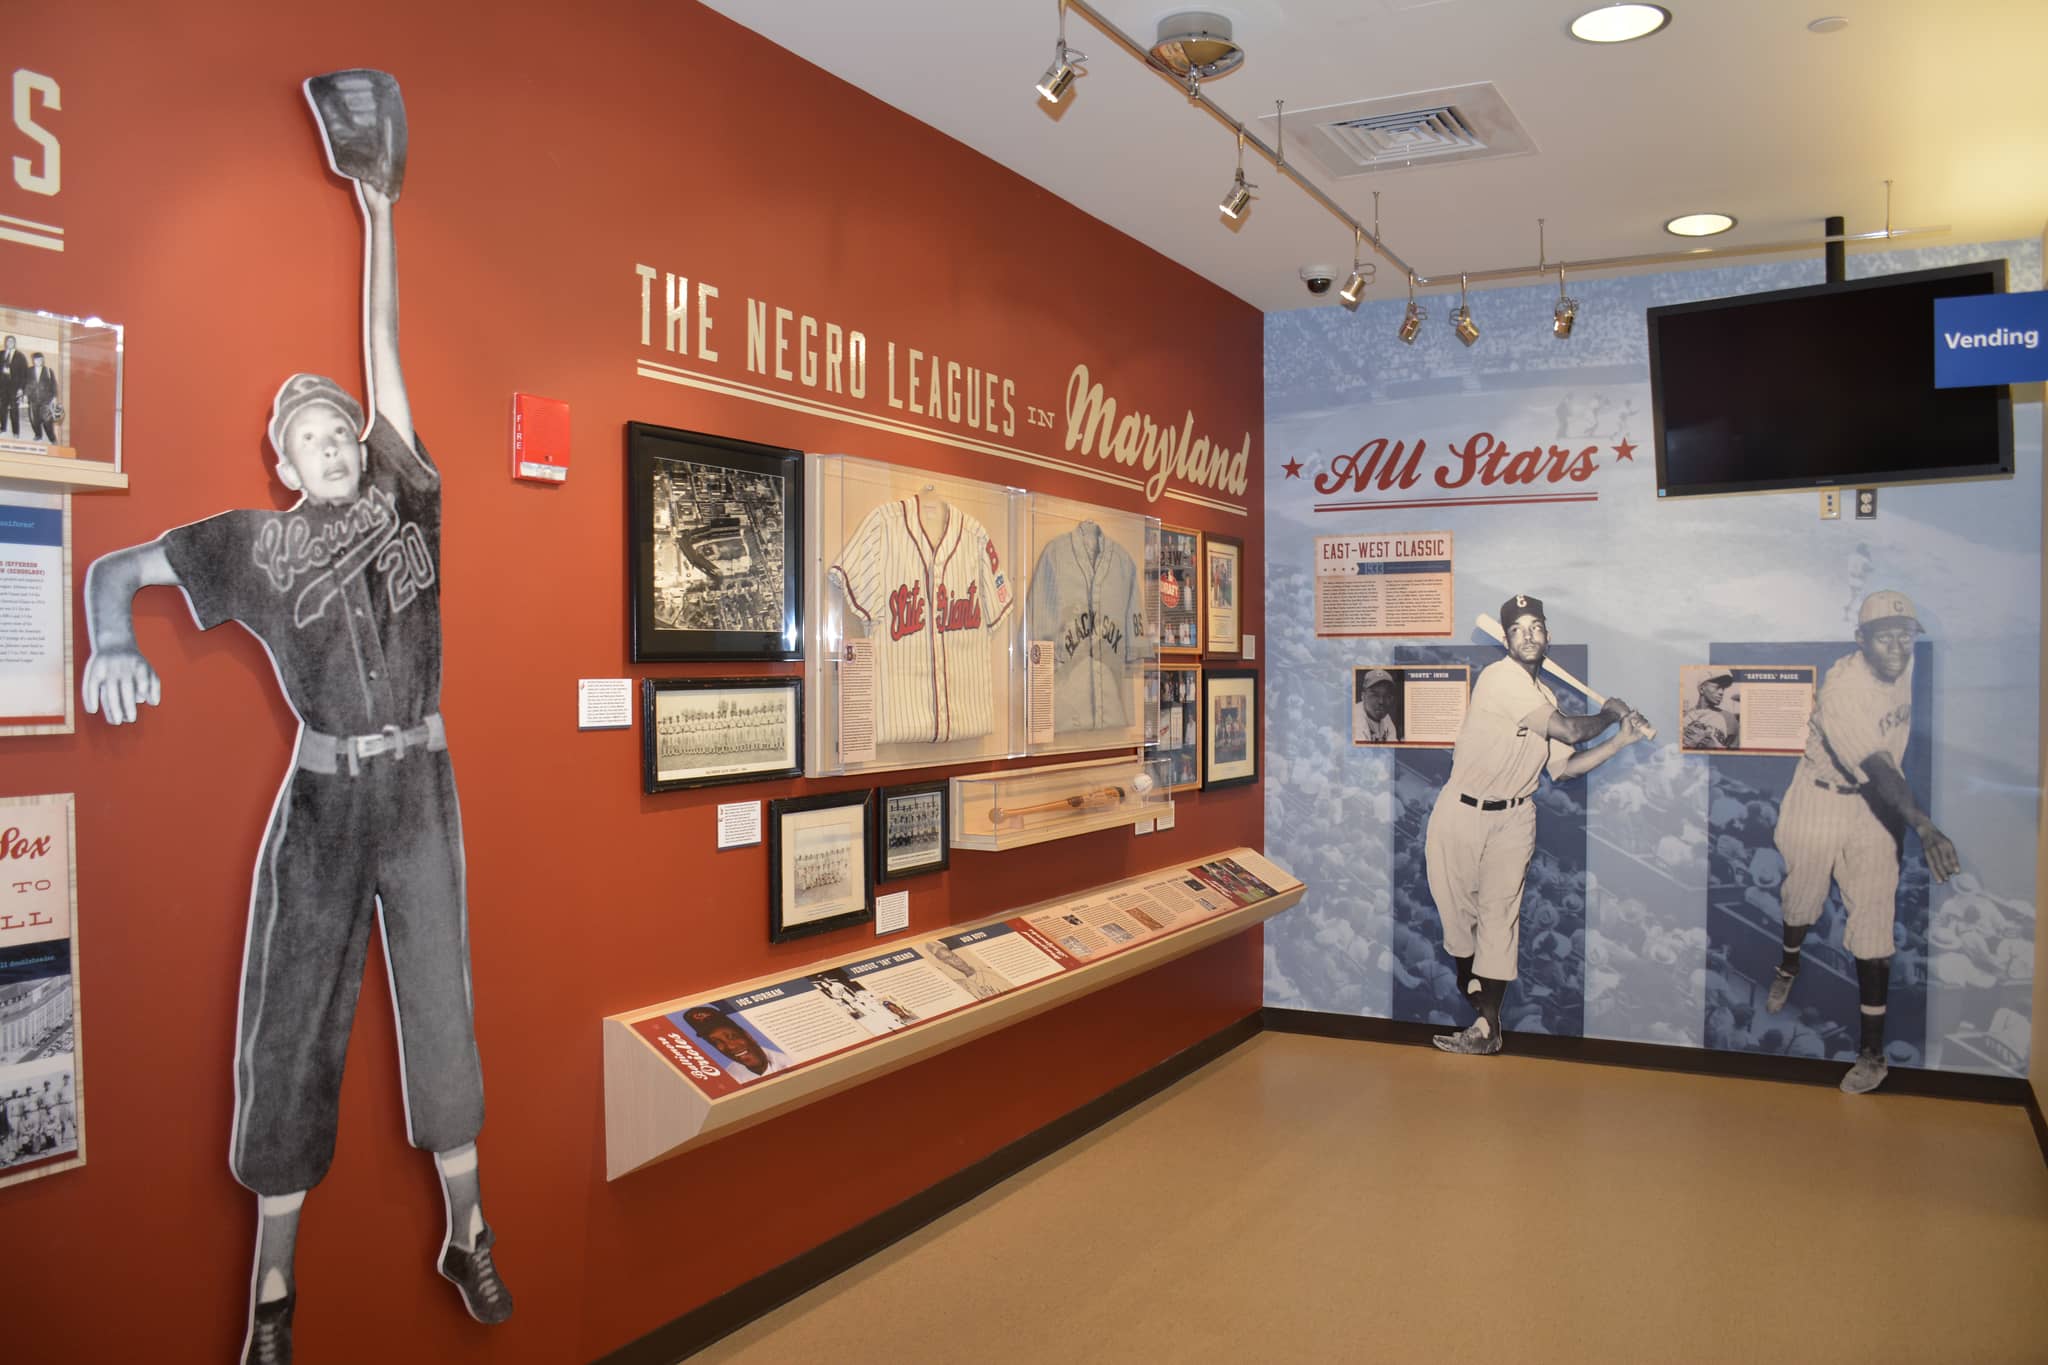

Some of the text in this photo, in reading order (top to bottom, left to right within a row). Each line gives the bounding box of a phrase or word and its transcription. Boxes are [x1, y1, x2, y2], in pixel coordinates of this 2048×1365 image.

[1944, 328, 2039, 349] Vending
[636, 263, 1251, 503] THE NEGRO LEAGUES IN Maryland
[1314, 432, 1600, 495] All Stars
[377, 522, 435, 613] 20
[1323, 540, 1444, 560] EAST-WEST CLASSIC
[935, 579, 981, 634] Giants
[1102, 615, 1122, 655] SOX
[12, 880, 51, 893] TO
[667, 1032, 721, 1077] Orioles
